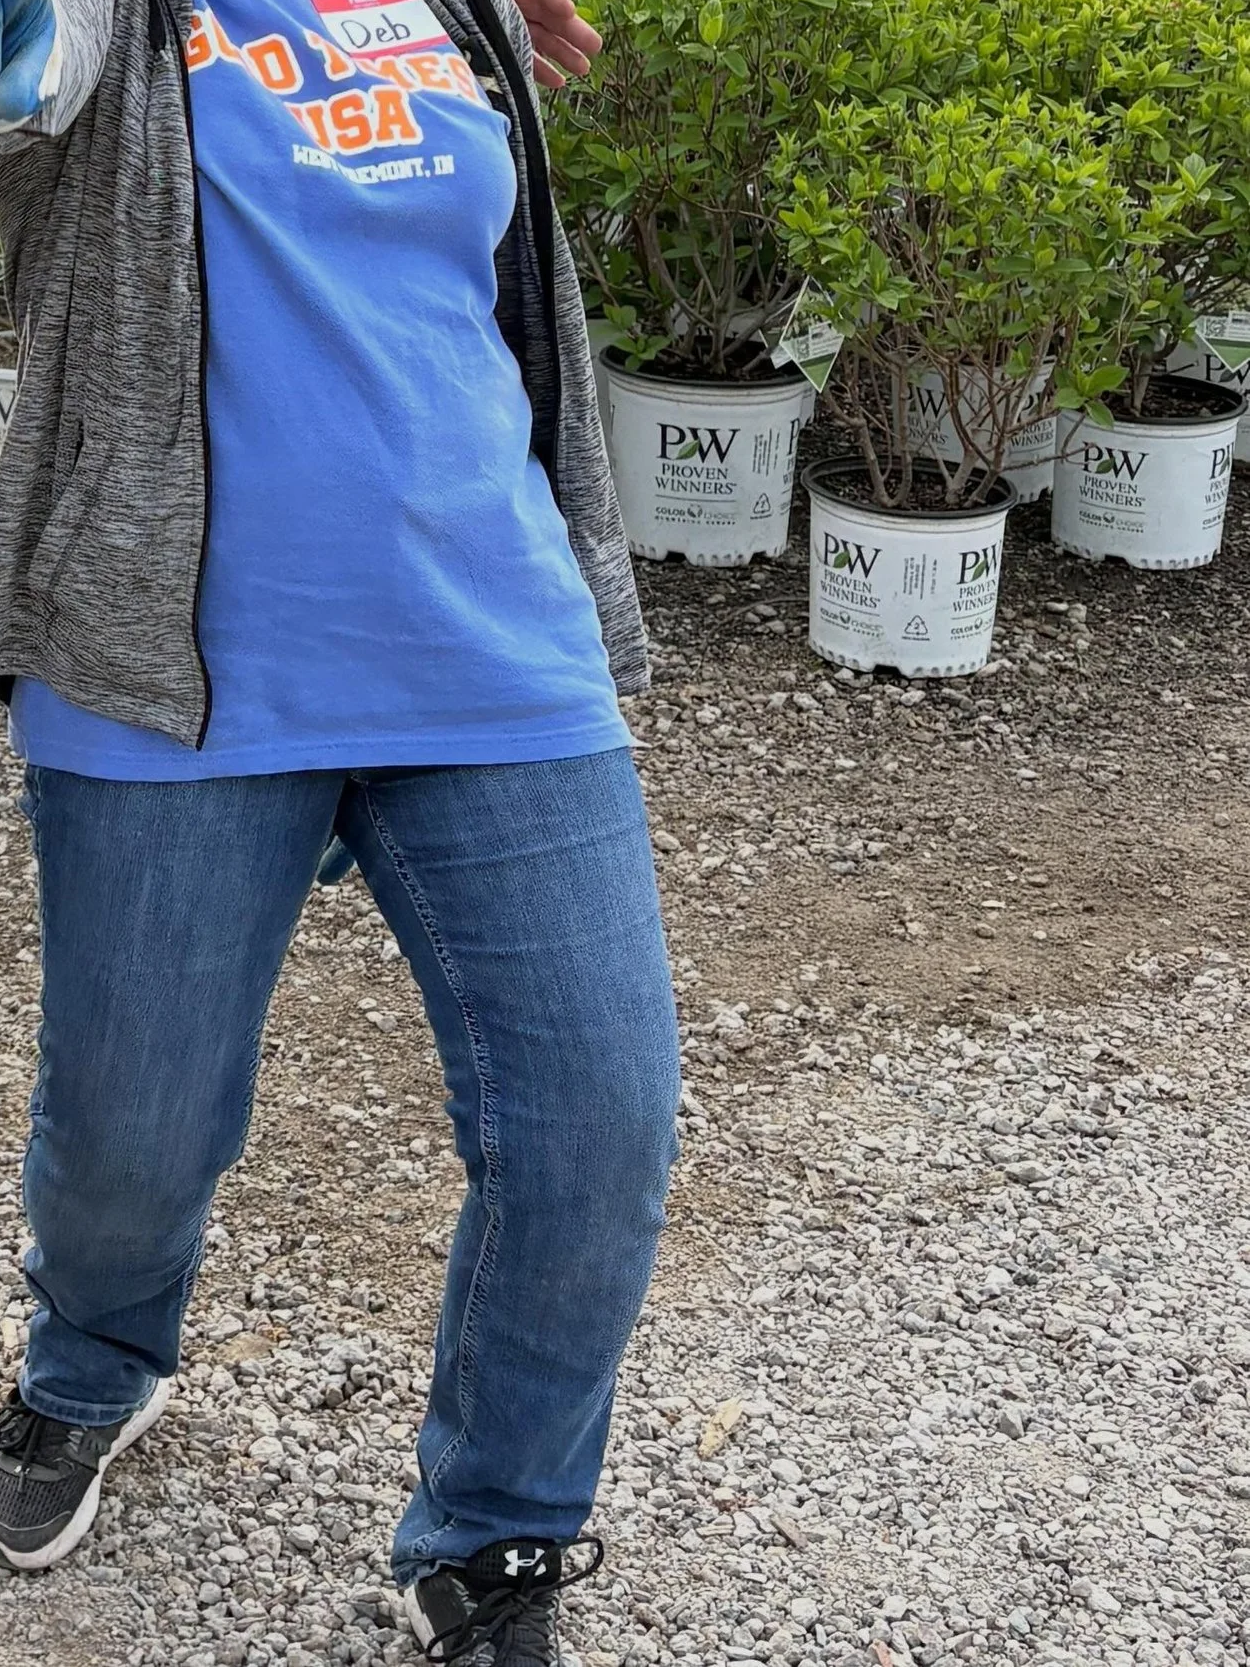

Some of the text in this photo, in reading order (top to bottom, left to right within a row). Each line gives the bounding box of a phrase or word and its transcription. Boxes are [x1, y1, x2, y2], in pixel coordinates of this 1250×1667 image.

[340, 12, 411, 49] Deb
[284, 84, 424, 156] USA
[432, 154, 455, 176] IN
[656, 422, 741, 464] PW
[661, 462, 729, 480] PROVEN
[1081, 440, 1150, 481] PW
[655, 476, 735, 496] WINNERS
[1079, 485, 1144, 508] WINNERS
[1084, 474, 1138, 496] PROVEN
[823, 531, 883, 579] PW
[819, 580, 879, 610] WINNERS
[823, 568, 872, 594] PROVEN
